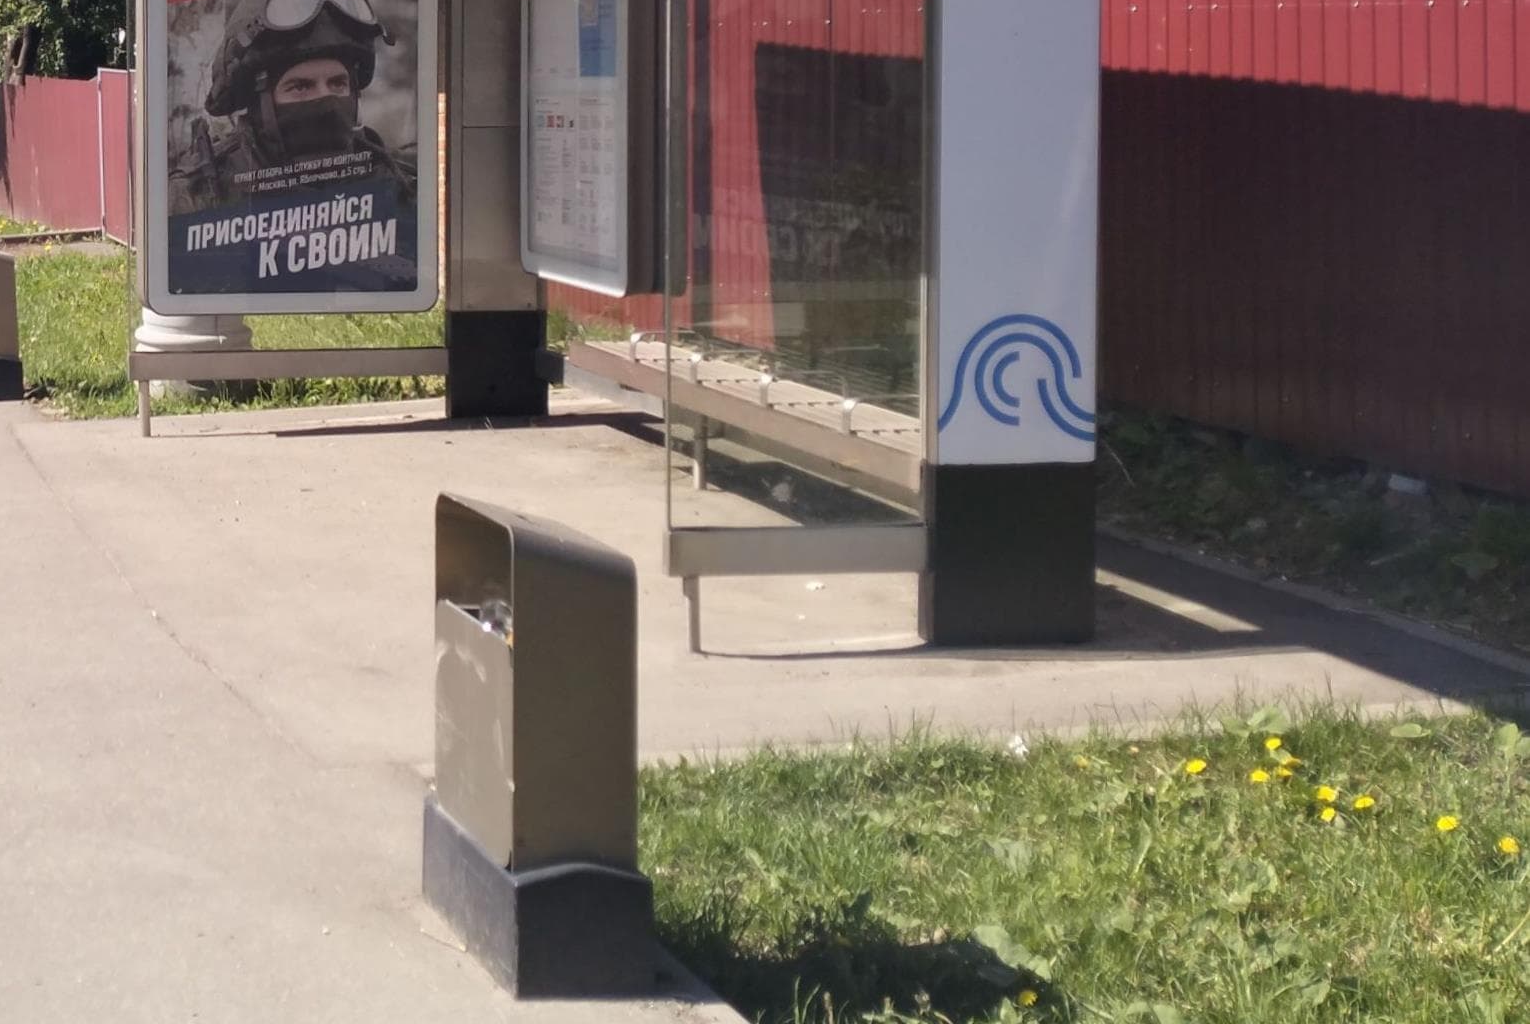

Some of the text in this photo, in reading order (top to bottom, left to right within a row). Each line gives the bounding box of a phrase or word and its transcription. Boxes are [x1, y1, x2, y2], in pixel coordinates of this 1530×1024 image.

[187, 193, 373, 252] ПРИСОЕДИНЯЙСЯ
[258, 218, 397, 279] К СВОИМ
